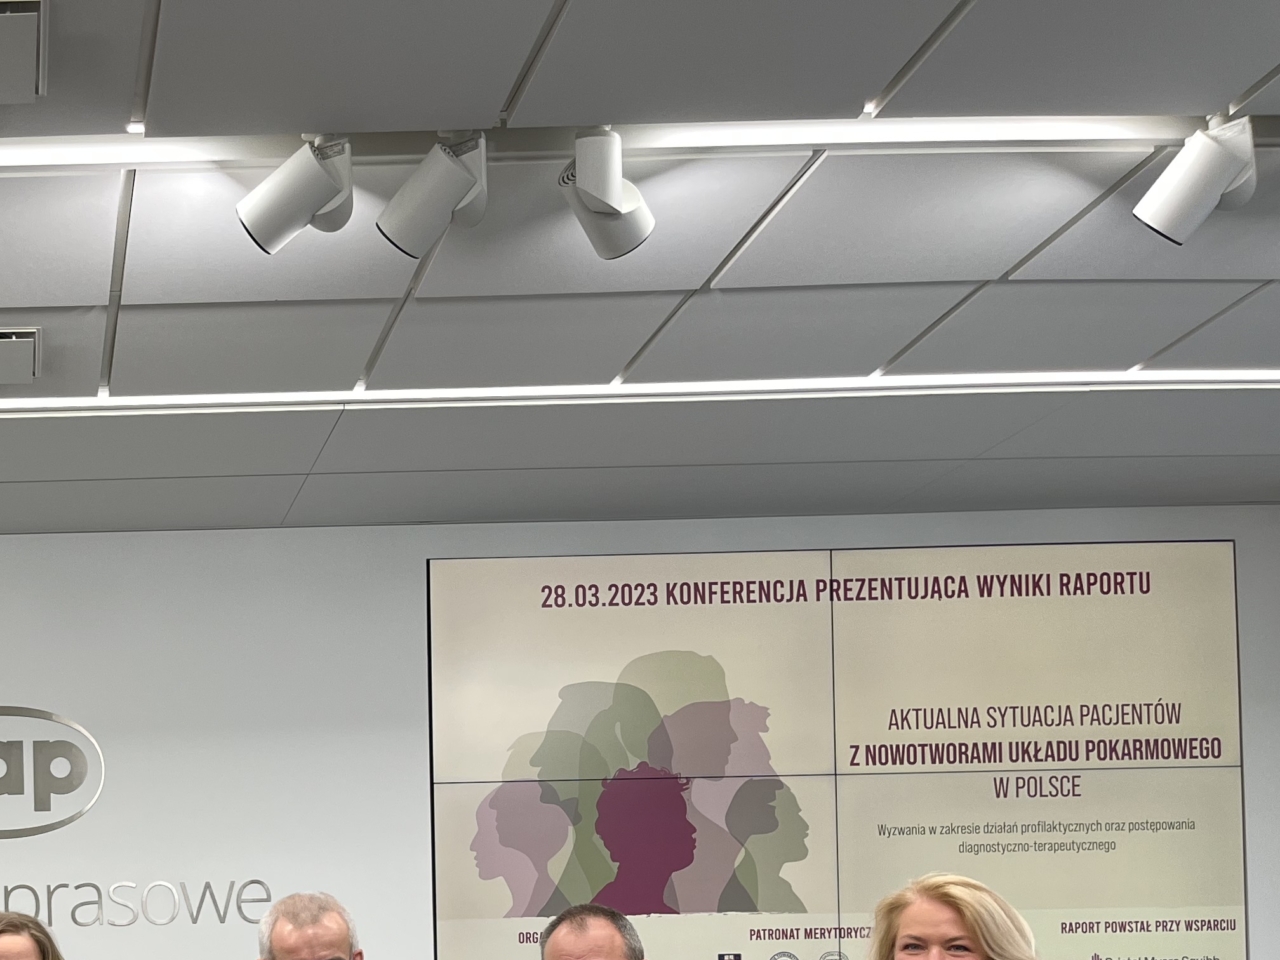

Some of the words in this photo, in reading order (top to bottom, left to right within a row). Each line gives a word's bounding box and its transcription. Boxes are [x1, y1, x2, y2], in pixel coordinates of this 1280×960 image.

[541, 582, 658, 608] 28.03.2023
[666, 580, 808, 605] KONFERENCJA
[816, 576, 970, 602] PREZENTUJĄCA
[976, 574, 1050, 598] WYNIKI
[1059, 571, 1150, 596] RAPORTU
[888, 707, 981, 730] AKTUALNA
[986, 705, 1074, 728] SYTUACJA
[1080, 698, 1182, 726] PACJENTÓW
[849, 744, 860, 766] Z
[864, 742, 1003, 766] NOWOTWORAMI
[1008, 739, 1080, 762] UKŁADU
[1085, 737, 1222, 762] POKARMOWEGO
[993, 777, 1010, 798] W
[1015, 775, 1082, 798] POLSCE
[877, 823, 926, 838] Wyzwania
[928, 826, 938, 835] w
[939, 822, 980, 835] zakresie
[982, 821, 1018, 834] działań
[1021, 820, 1102, 836] profilaktycznych
[1104, 822, 1126, 832] oraz
[1128, 818, 1196, 834] postępowania
[958, 839, 1116, 855] diagnostyczno-terapeutycznego
[750, 928, 800, 940] PATRONAT
[804, 926, 872, 940] MERYTORYCZ
[1061, 922, 1100, 934] RAPORT
[1104, 920, 1152, 934] POWSTAŁ
[1155, 920, 1180, 932] PRZY
[1184, 918, 1236, 932] WSPARCIU
